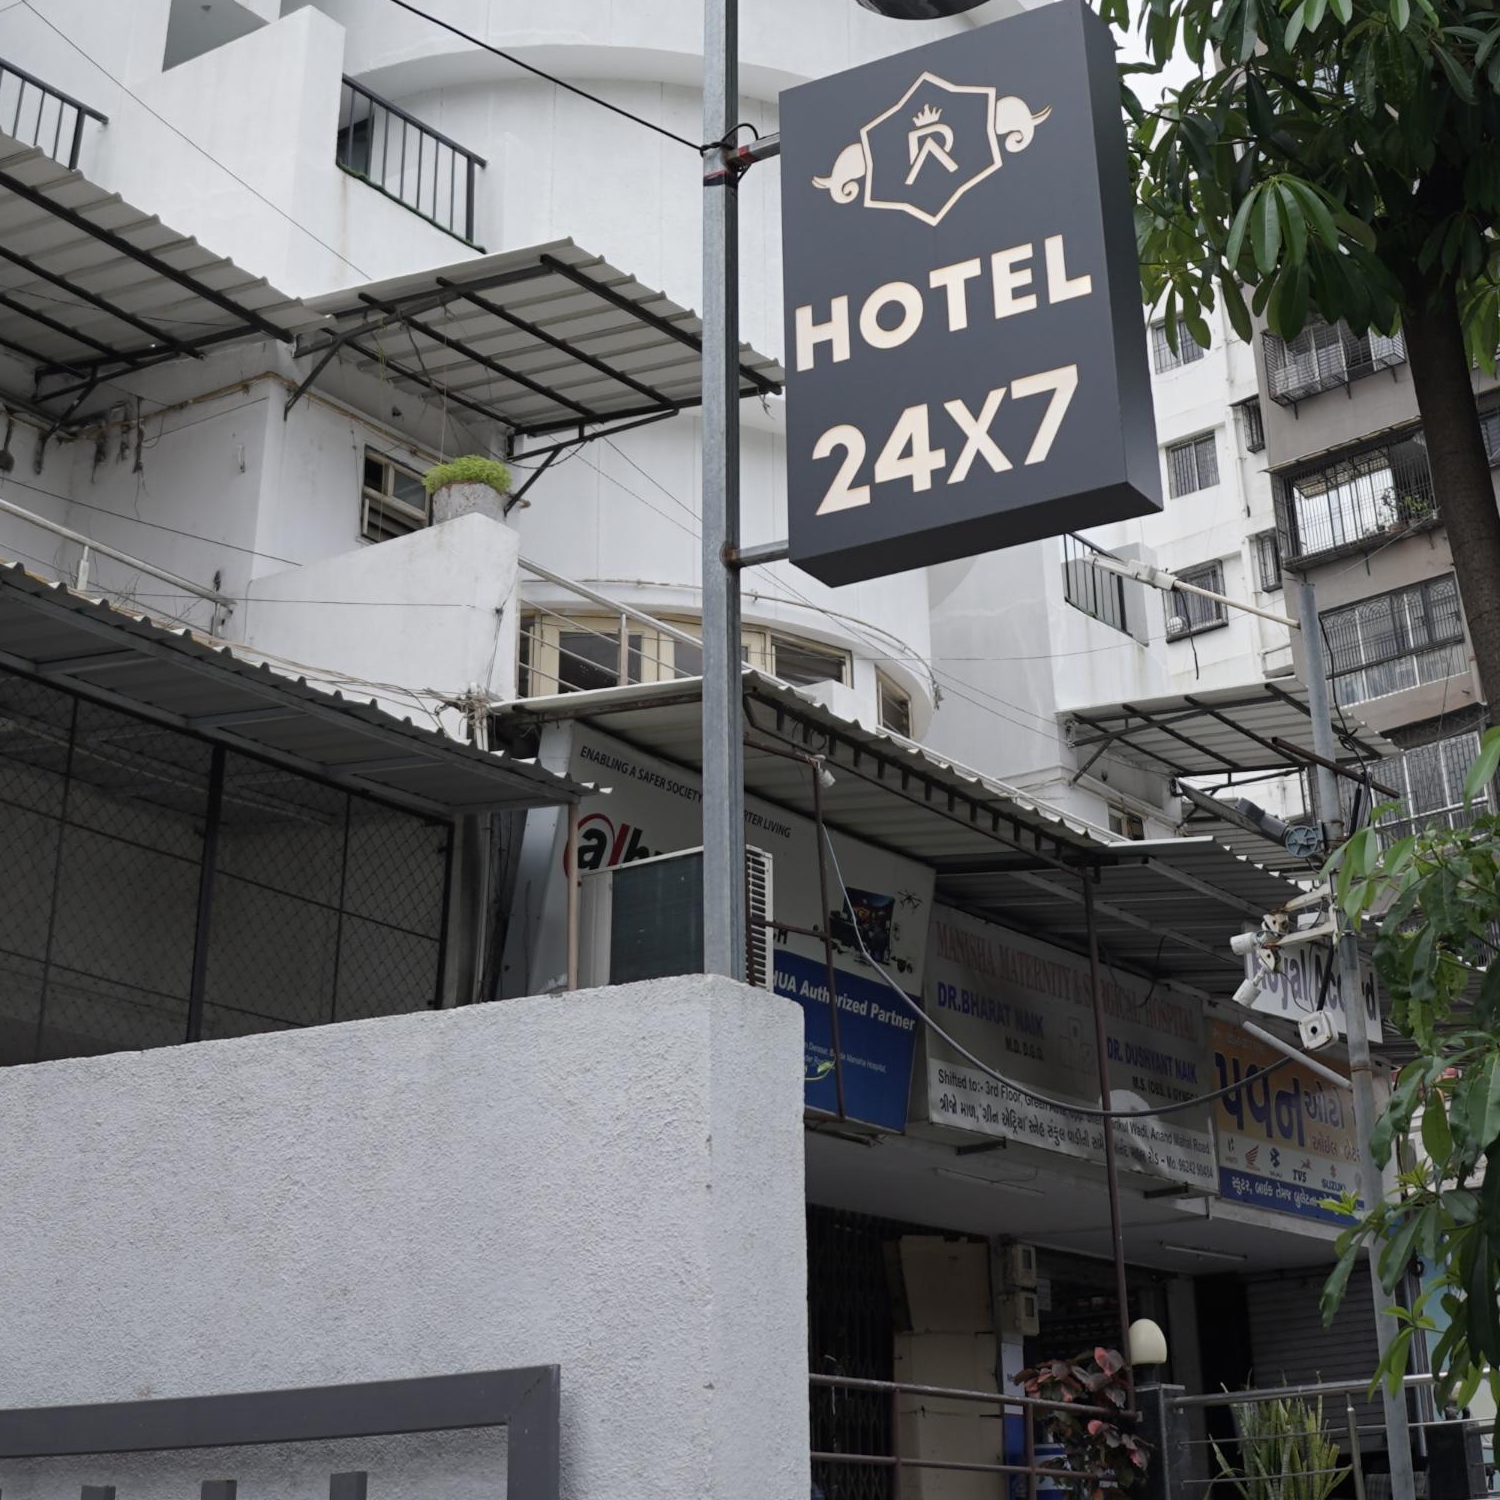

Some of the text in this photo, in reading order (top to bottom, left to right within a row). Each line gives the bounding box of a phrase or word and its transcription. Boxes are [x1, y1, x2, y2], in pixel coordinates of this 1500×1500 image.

[795, 234, 1093, 372] HOTEL
[811, 364, 1078, 516] 24X7
[580, 746, 628, 774] ENABLING
[629, 765, 636, 778] A
[637, 768, 666, 791] SAFER
[667, 780, 703, 803] SOCIETY
[764, 821, 791, 838] LIVING
[935, 920, 995, 977] MANISHA
[998, 943, 1072, 1002] MATERNITY
[871, 1002, 916, 1031] Partner
[1013, 1006, 1045, 1040] NAIK
[938, 1068, 967, 1090] Shifted
[985, 1081, 999, 1098] 3rd
[1000, 1086, 1023, 1107] Floor,
[1125, 1043, 1173, 1077] DUSHYANT
[1175, 1058, 1198, 1085] NAIK
[1215, 1052, 1305, 1147] પવન
[1292, 1169, 1307, 1183] TVS
